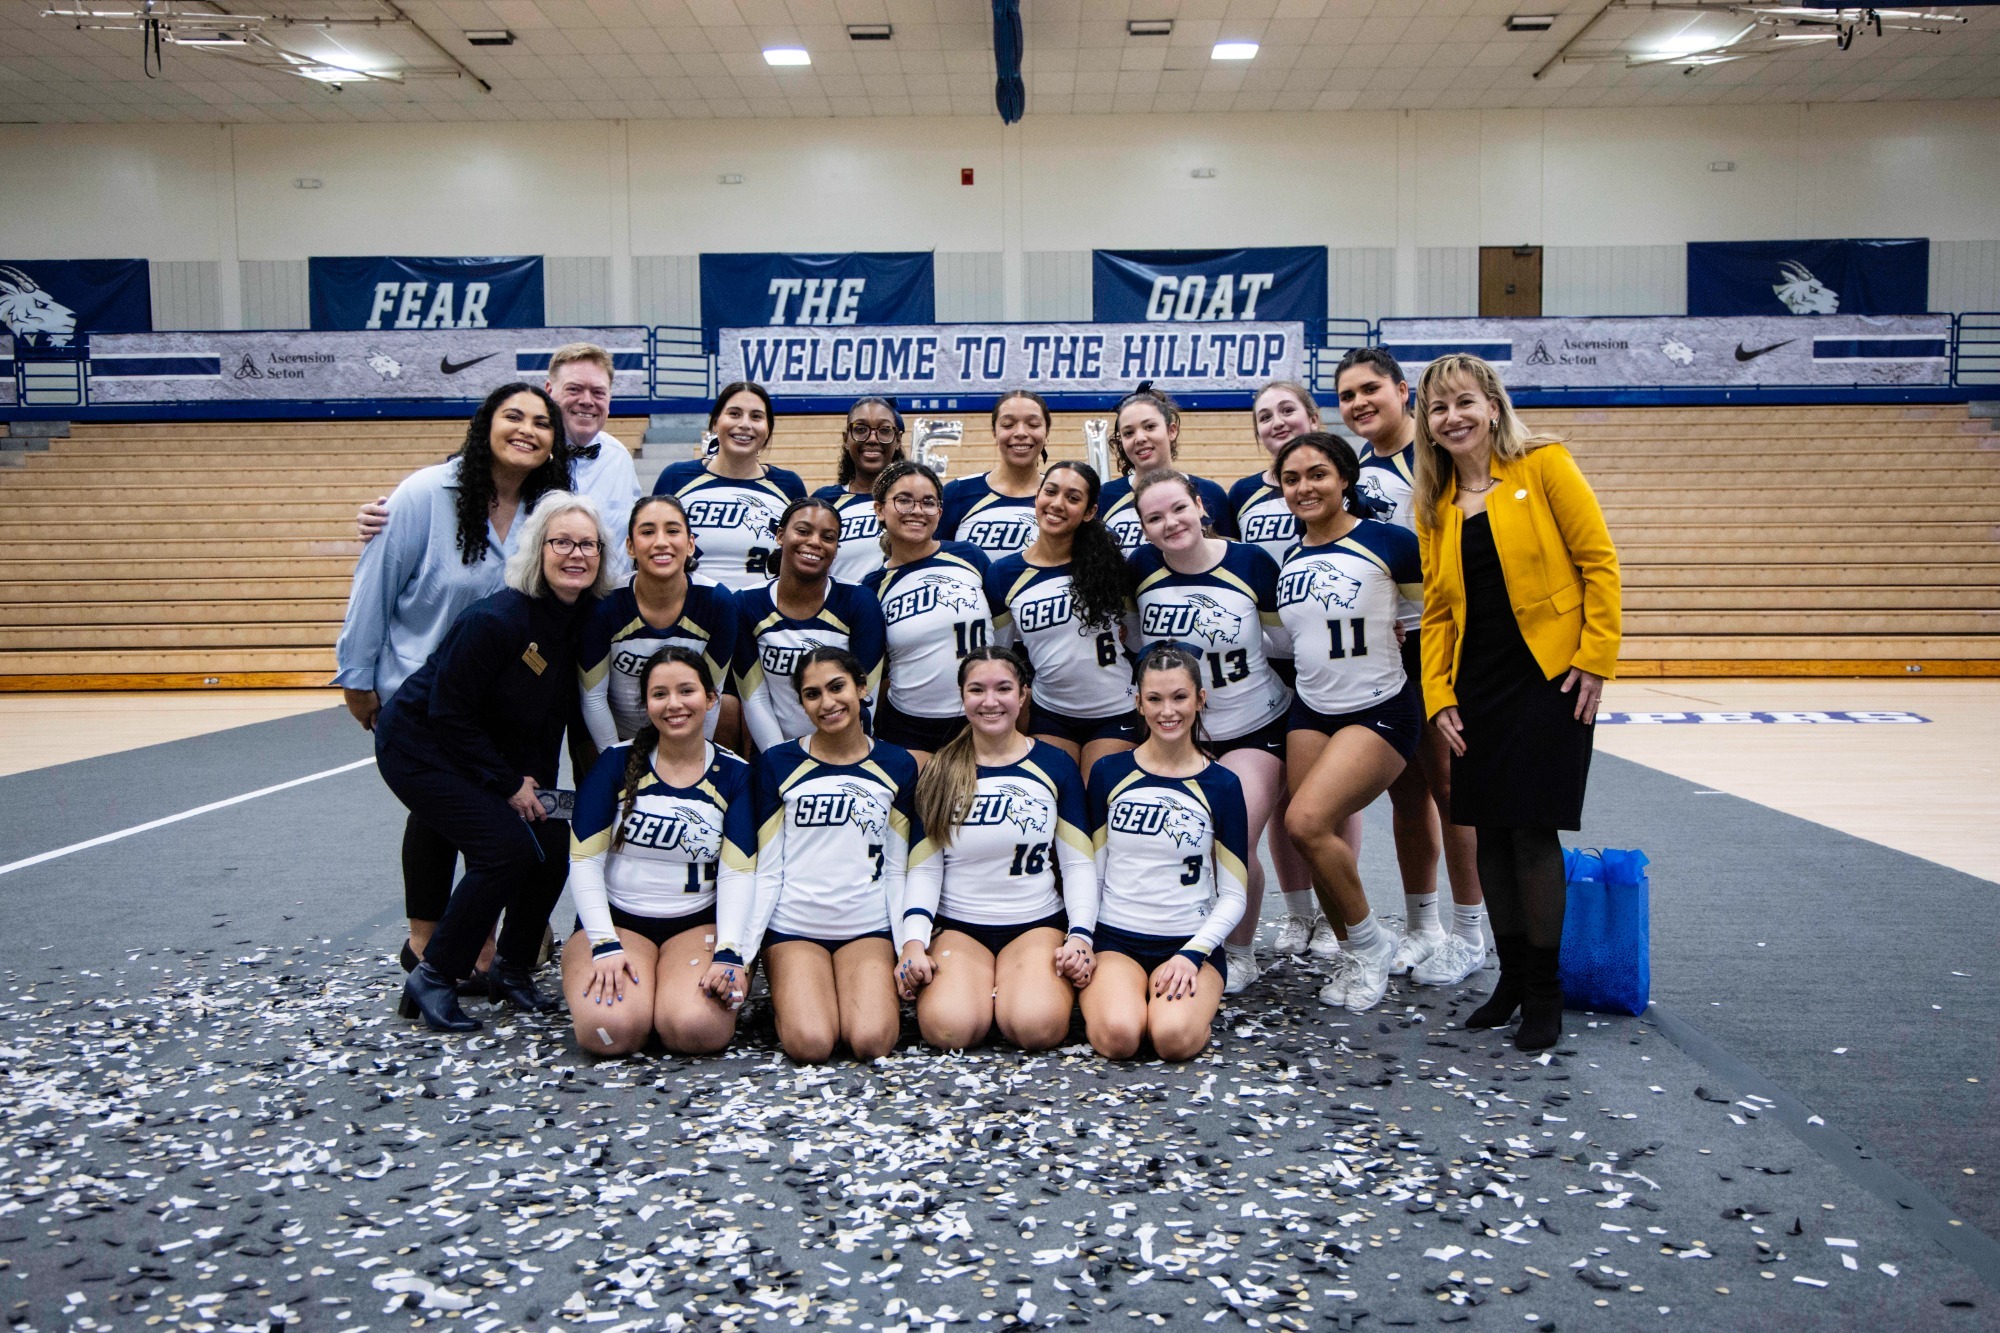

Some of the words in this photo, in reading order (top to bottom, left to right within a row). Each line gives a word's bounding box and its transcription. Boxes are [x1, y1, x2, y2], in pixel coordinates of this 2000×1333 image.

[365, 282, 490, 329] FEAR
[768, 278, 865, 325] THE
[1145, 274, 1273, 321] GOAT
[267, 352, 335, 364] Ascension
[739, 336, 937, 383] WELCOME
[955, 335, 1006, 381] TO
[1023, 334, 1104, 380] THE
[1120, 333, 1286, 379] HILLTOP
[1559, 353, 1597, 365] Seton
[1560, 338, 1629, 351] Ascension
[267, 367, 304, 379] Seton
[688, 501, 745, 529] SEU
[839, 515, 881, 541] SEU
[1245, 514, 1297, 541] SEU
[968, 521, 1028, 550] SEU
[1113, 521, 1150, 548] SE
[886, 585, 938, 626] SEU
[1020, 594, 1073, 632] SEU
[1142, 604, 1199, 636] SEU
[954, 619, 986, 658] 10
[1096, 633, 1117, 667] 6
[1327, 618, 1368, 659] 11
[613, 651, 650, 676] SE
[1207, 649, 1249, 688] 13
[1597, 711, 1932, 724] PERS
[795, 794, 852, 827] SEU
[1111, 801, 1168, 835] SEU
[624, 810, 682, 850] SEU
[868, 844, 883, 882] 7
[1010, 843, 1048, 875] 16
[1180, 855, 1202, 886] 3
